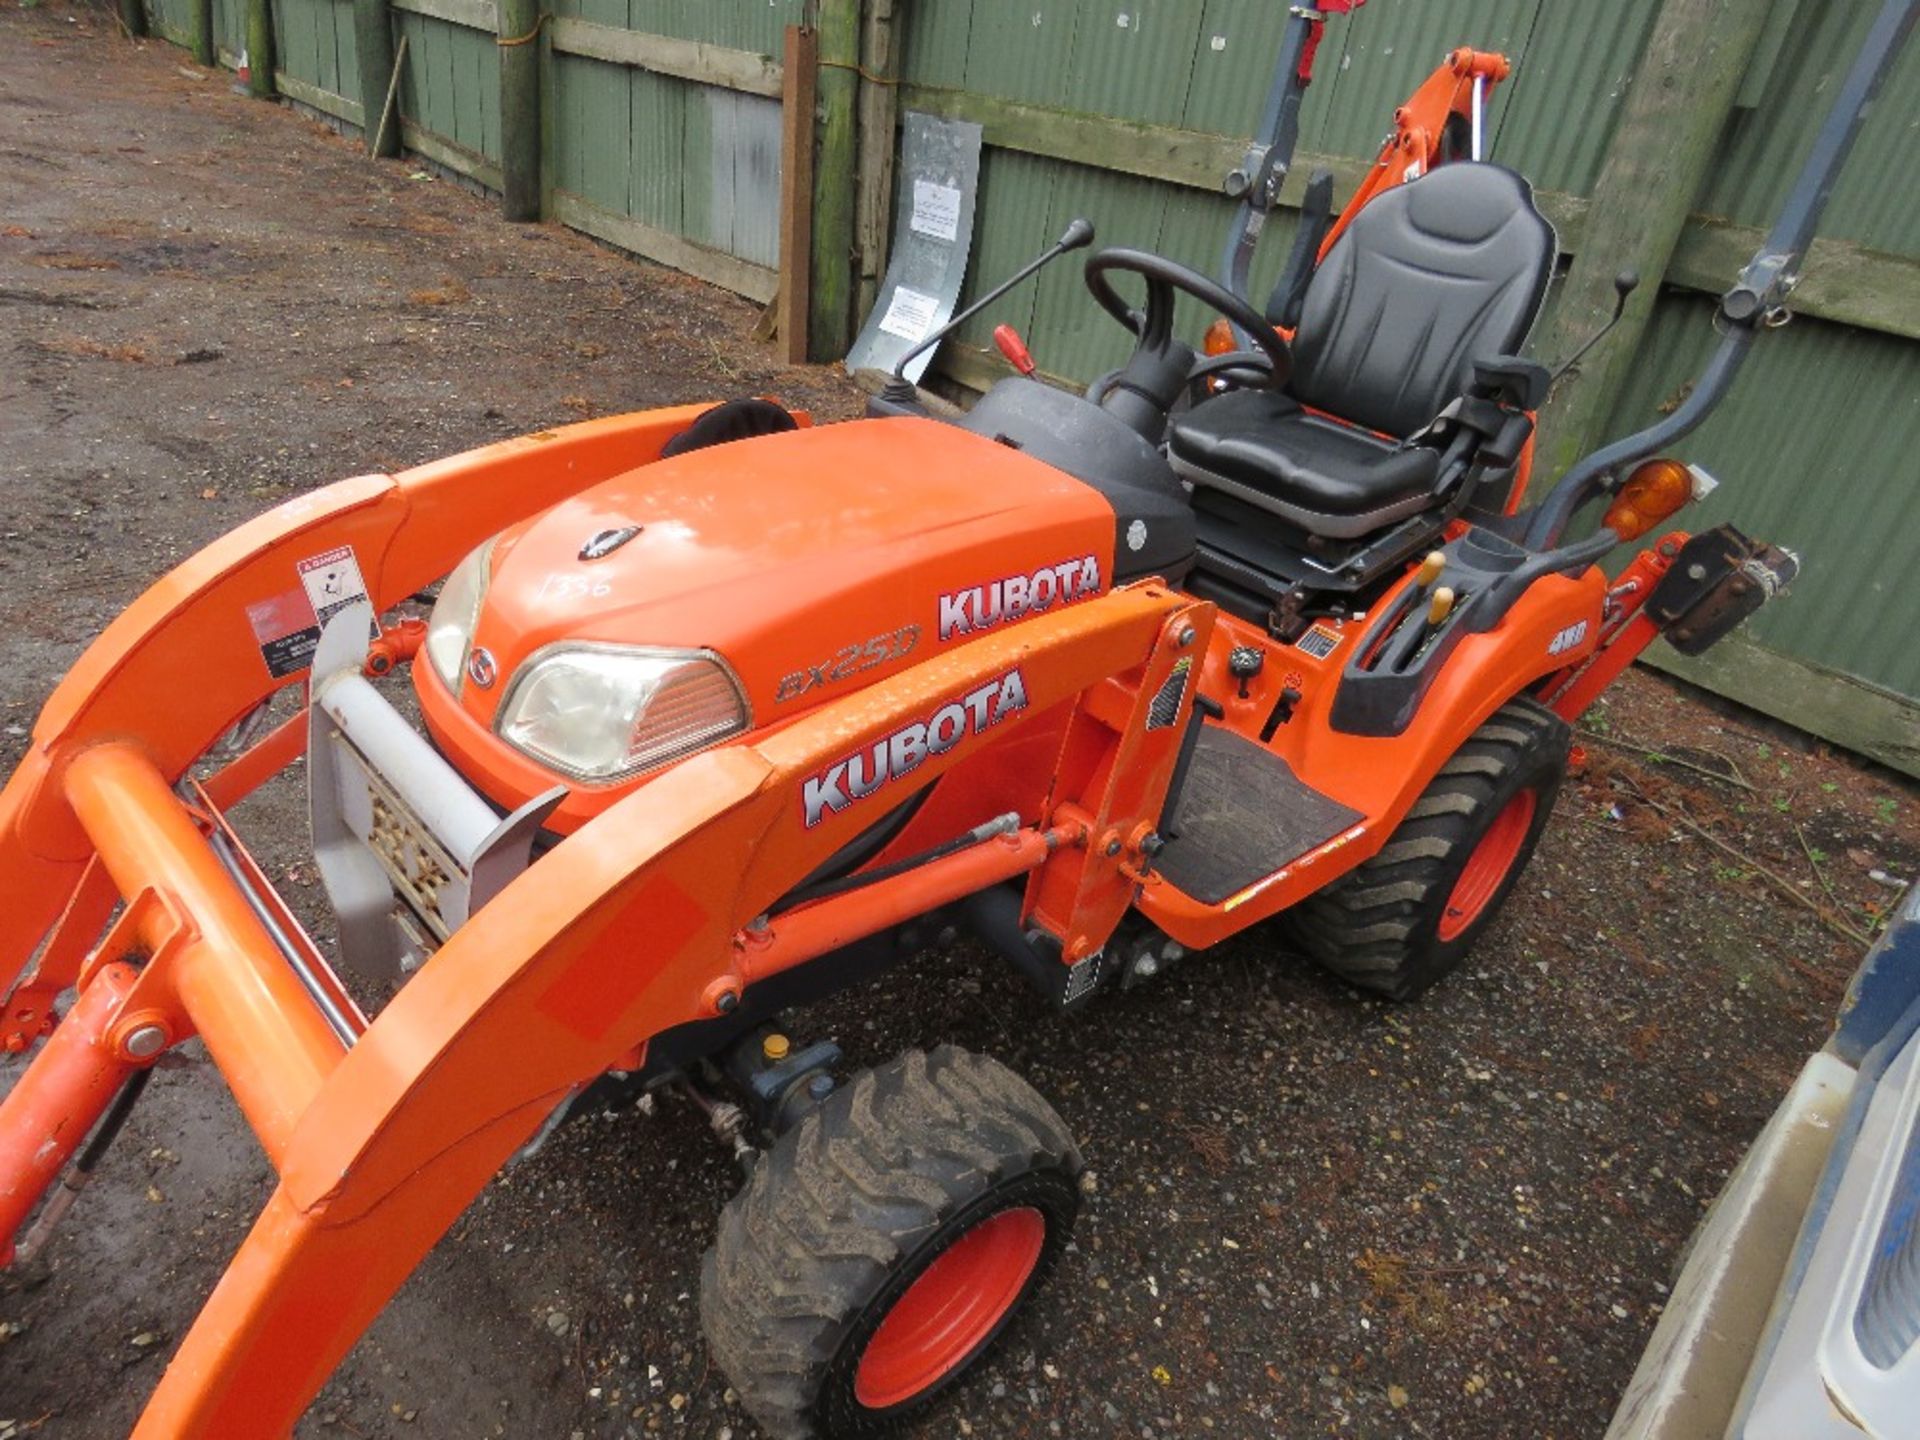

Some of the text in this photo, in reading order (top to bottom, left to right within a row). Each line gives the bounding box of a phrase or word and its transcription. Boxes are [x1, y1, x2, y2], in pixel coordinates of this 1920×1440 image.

[938, 555, 1100, 640] KUBOTA
[1547, 620, 1586, 654] 4WD
[802, 668, 1028, 827] KUBOTA
